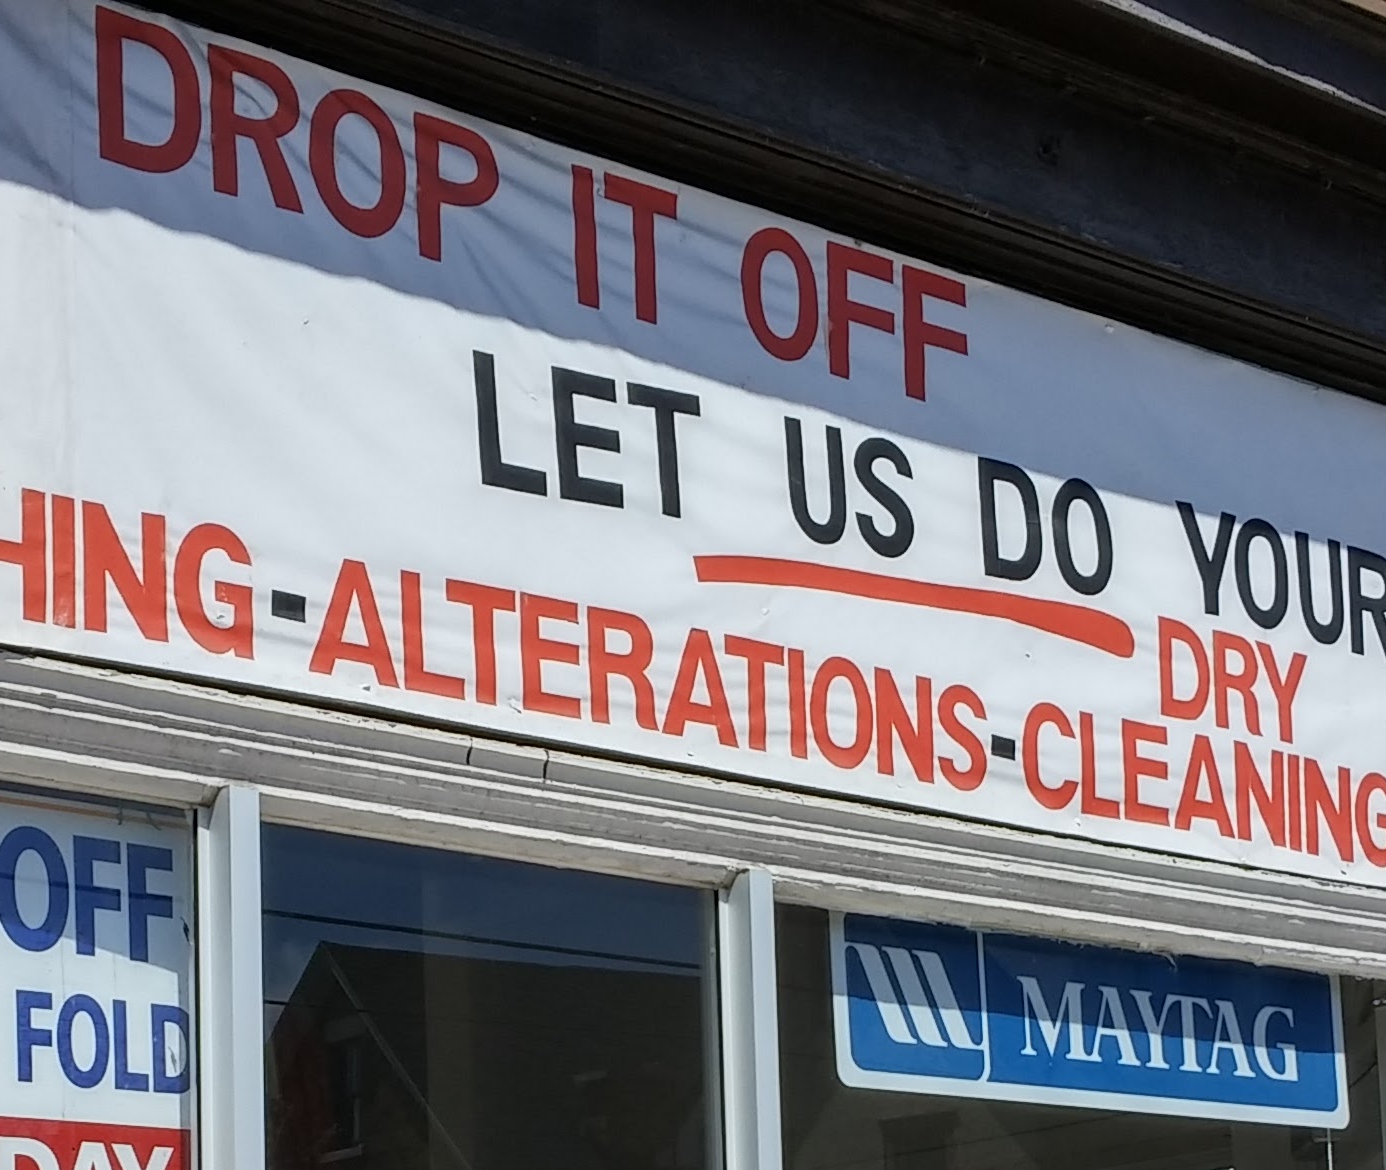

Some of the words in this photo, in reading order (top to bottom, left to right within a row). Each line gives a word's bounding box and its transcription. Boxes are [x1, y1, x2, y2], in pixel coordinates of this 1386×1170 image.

[94, 4, 501, 263] DROP
[571, 164, 678, 325] IT
[741, 227, 968, 402] OFF
[472, 350, 701, 519] LET
[784, 416, 915, 557] US
[977, 455, 1114, 596] DO
[1157, 615, 1308, 744] DRY
[16, 990, 191, 1095] FOLD
[1016, 974, 1300, 1083] MAYTAG
